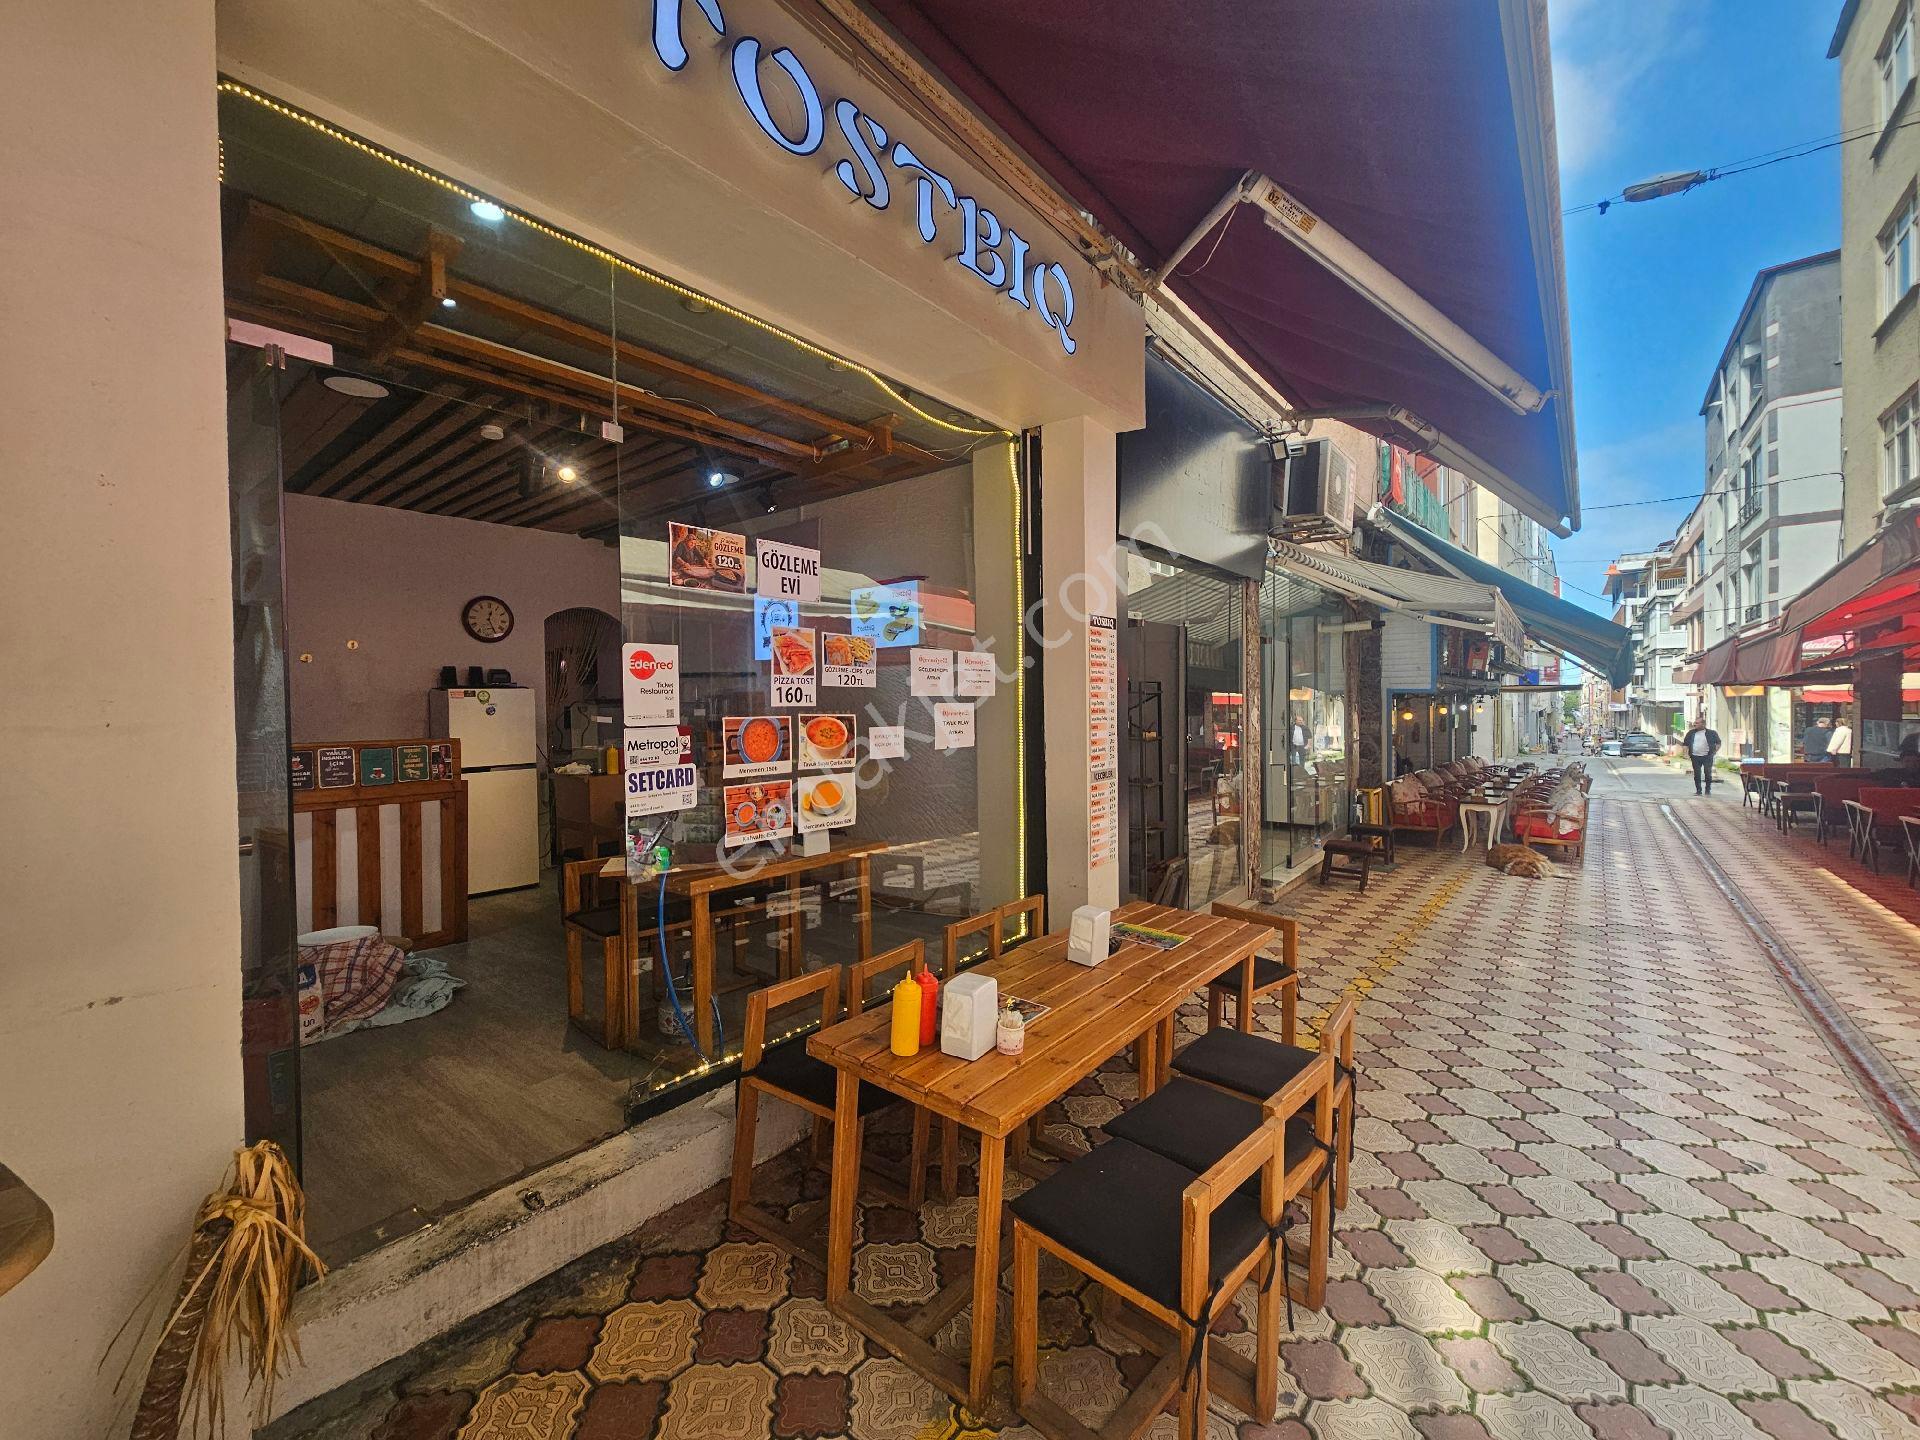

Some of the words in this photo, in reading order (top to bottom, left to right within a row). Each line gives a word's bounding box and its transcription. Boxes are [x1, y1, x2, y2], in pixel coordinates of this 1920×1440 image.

[714, 542, 744, 555] GÖZLEME
[761, 549, 819, 577] GÖZLEME
[781, 575, 801, 596] EVİ
[629, 658, 674, 670] Edenred
[773, 676, 795, 685] PİZZA
[797, 677, 815, 685] TOST
[640, 687, 674, 695] Restaurant
[627, 737, 678, 752] Metropol
[663, 748, 679, 756] Card
[628, 767, 694, 794] SETCARD
